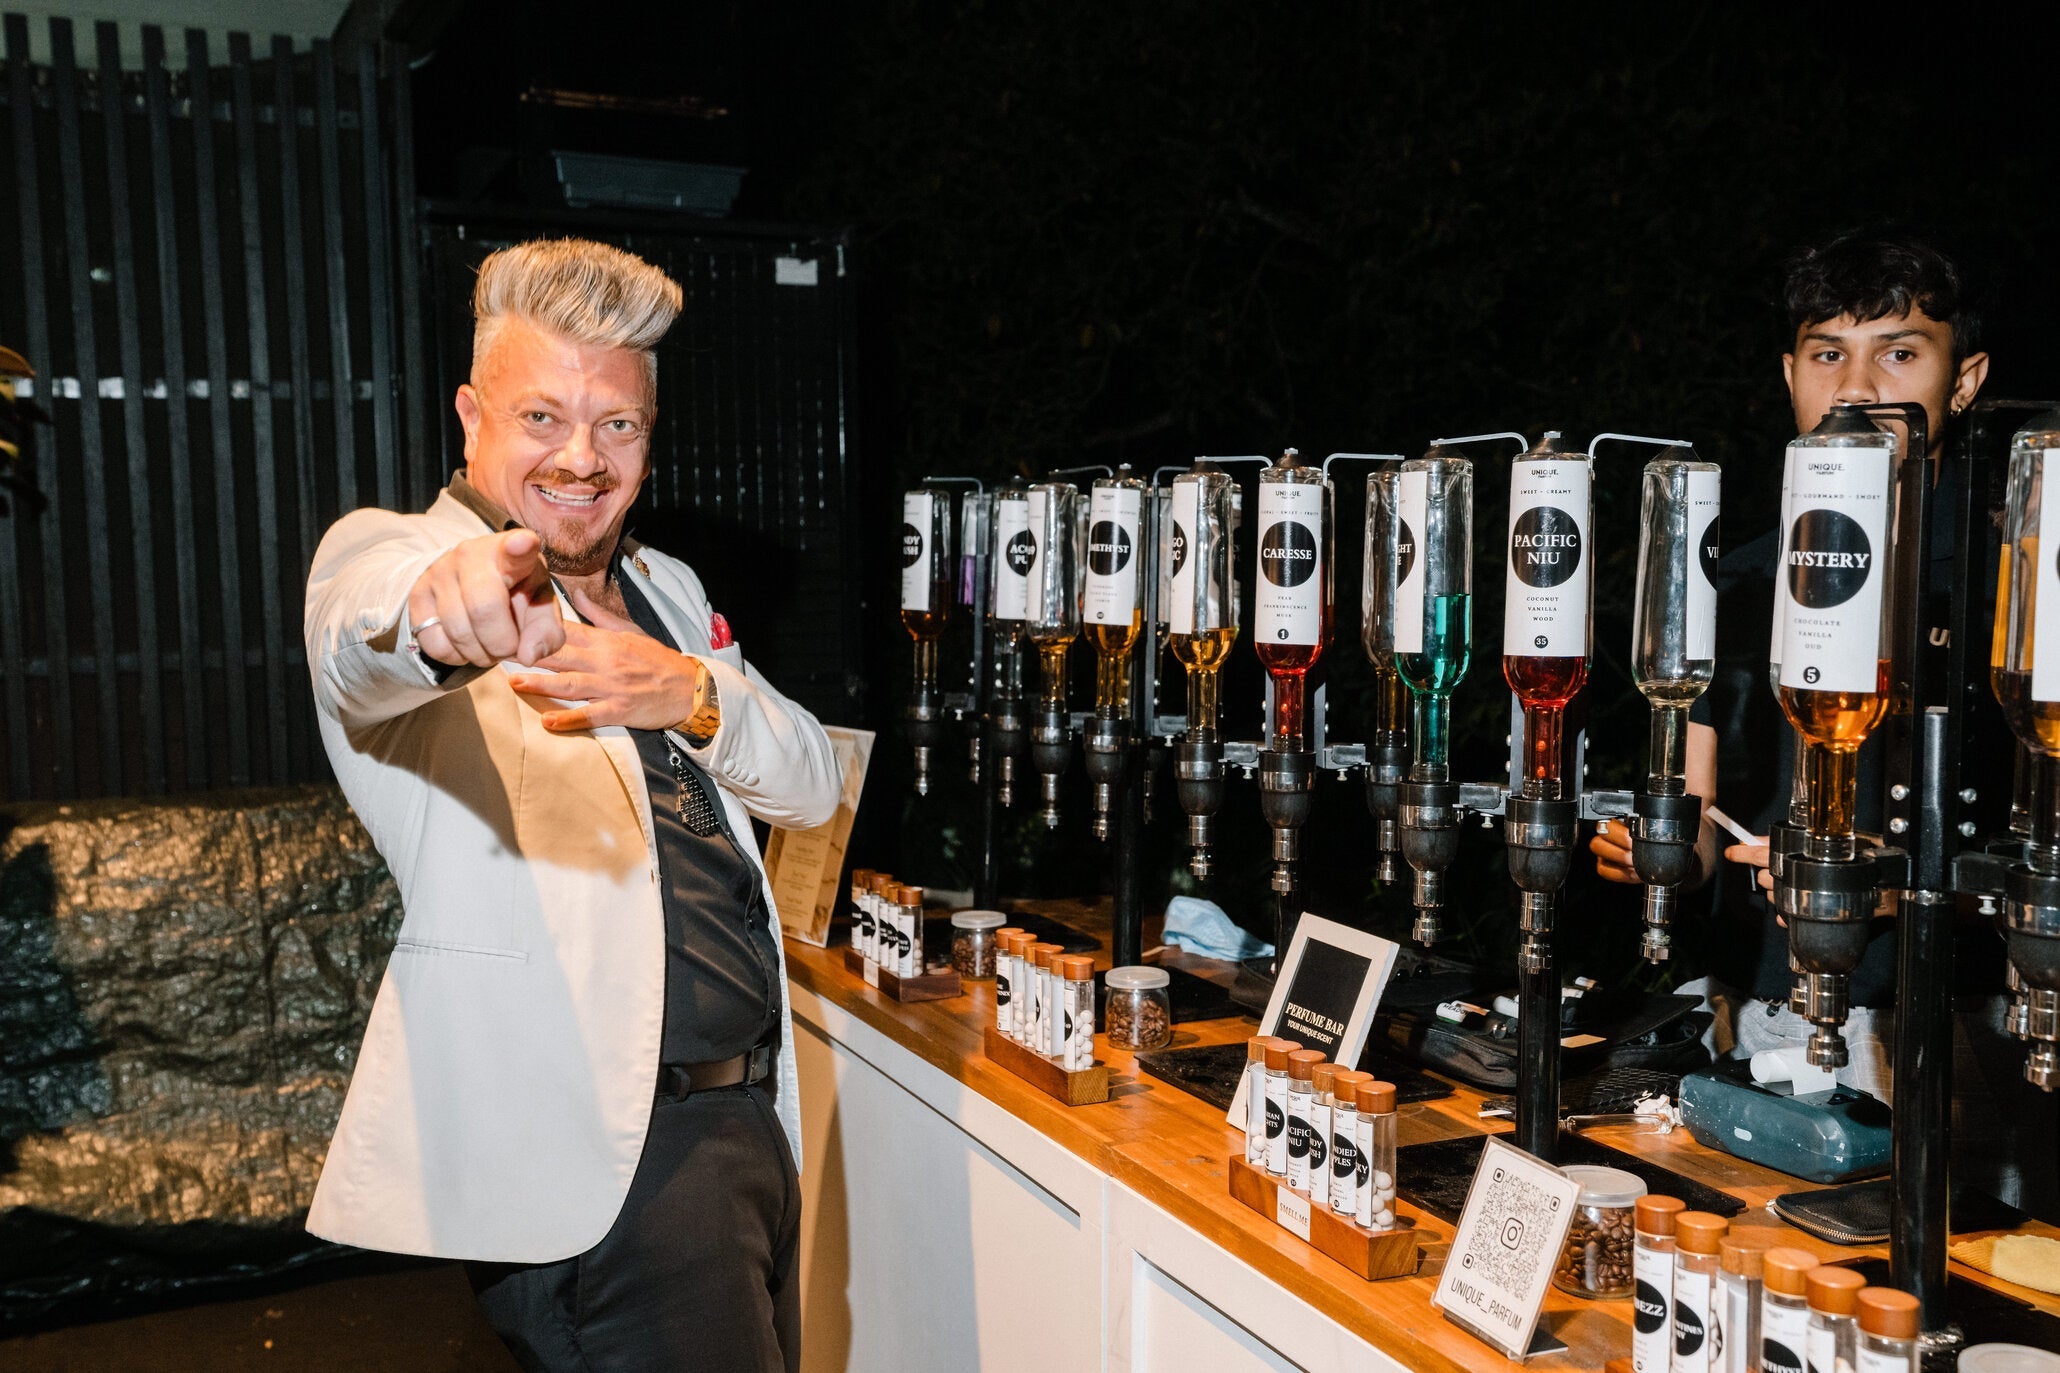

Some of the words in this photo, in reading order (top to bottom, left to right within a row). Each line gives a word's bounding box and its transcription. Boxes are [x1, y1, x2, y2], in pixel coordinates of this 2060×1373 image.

[1514, 534, 1576, 547] PACIFIC
[1263, 548, 1312, 560] CARESSE
[1526, 552, 1560, 565] NIU
[1789, 550, 1870, 568] MYSTERY
[1794, 618, 1841, 626] CHOCOLATE
[1807, 668, 1817, 682] 5
[1285, 1002, 1326, 1027] PERFUME
[1324, 1017, 1344, 1036] BAR
[1287, 1020, 1300, 1031] YOUR
[1300, 1024, 1319, 1038] UNIQUE
[1316, 1032, 1334, 1044] SCENT
[1280, 1202, 1298, 1220] SMELL
[1299, 1214, 1308, 1226] ME
[1450, 1277, 1522, 1332] UNIQUE_PARFUM
